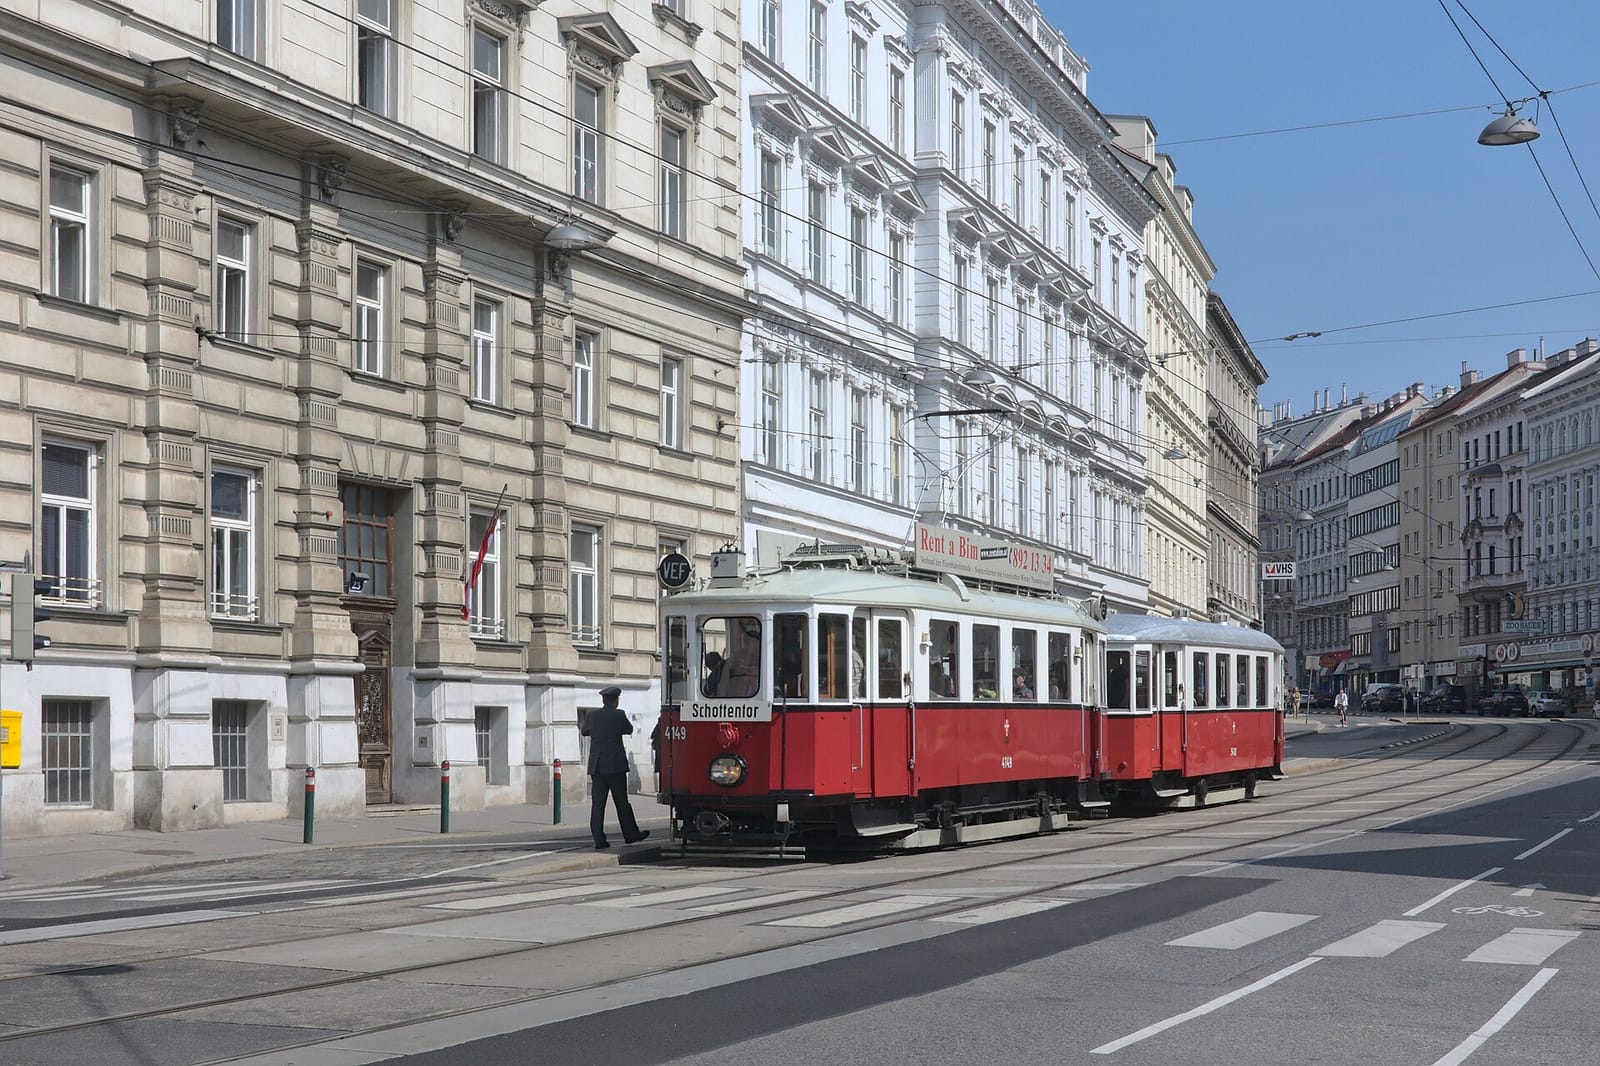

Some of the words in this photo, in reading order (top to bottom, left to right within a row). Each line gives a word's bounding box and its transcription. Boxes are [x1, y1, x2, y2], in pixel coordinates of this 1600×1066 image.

[921, 528, 945, 554] Rent
[949, 540, 955, 556] a
[959, 536, 978, 561] Bim
[1012, 548, 1028, 570] 892
[1031, 552, 1040, 573] 13
[1042, 553, 1052, 575] 34
[1276, 563, 1293, 574] VHS
[663, 562, 687, 580] VEF
[352, 580, 361, 590] 23
[1504, 621, 1519, 630] ZOO
[692, 703, 759, 719] Schottentor
[664, 726, 686, 741] 4149
